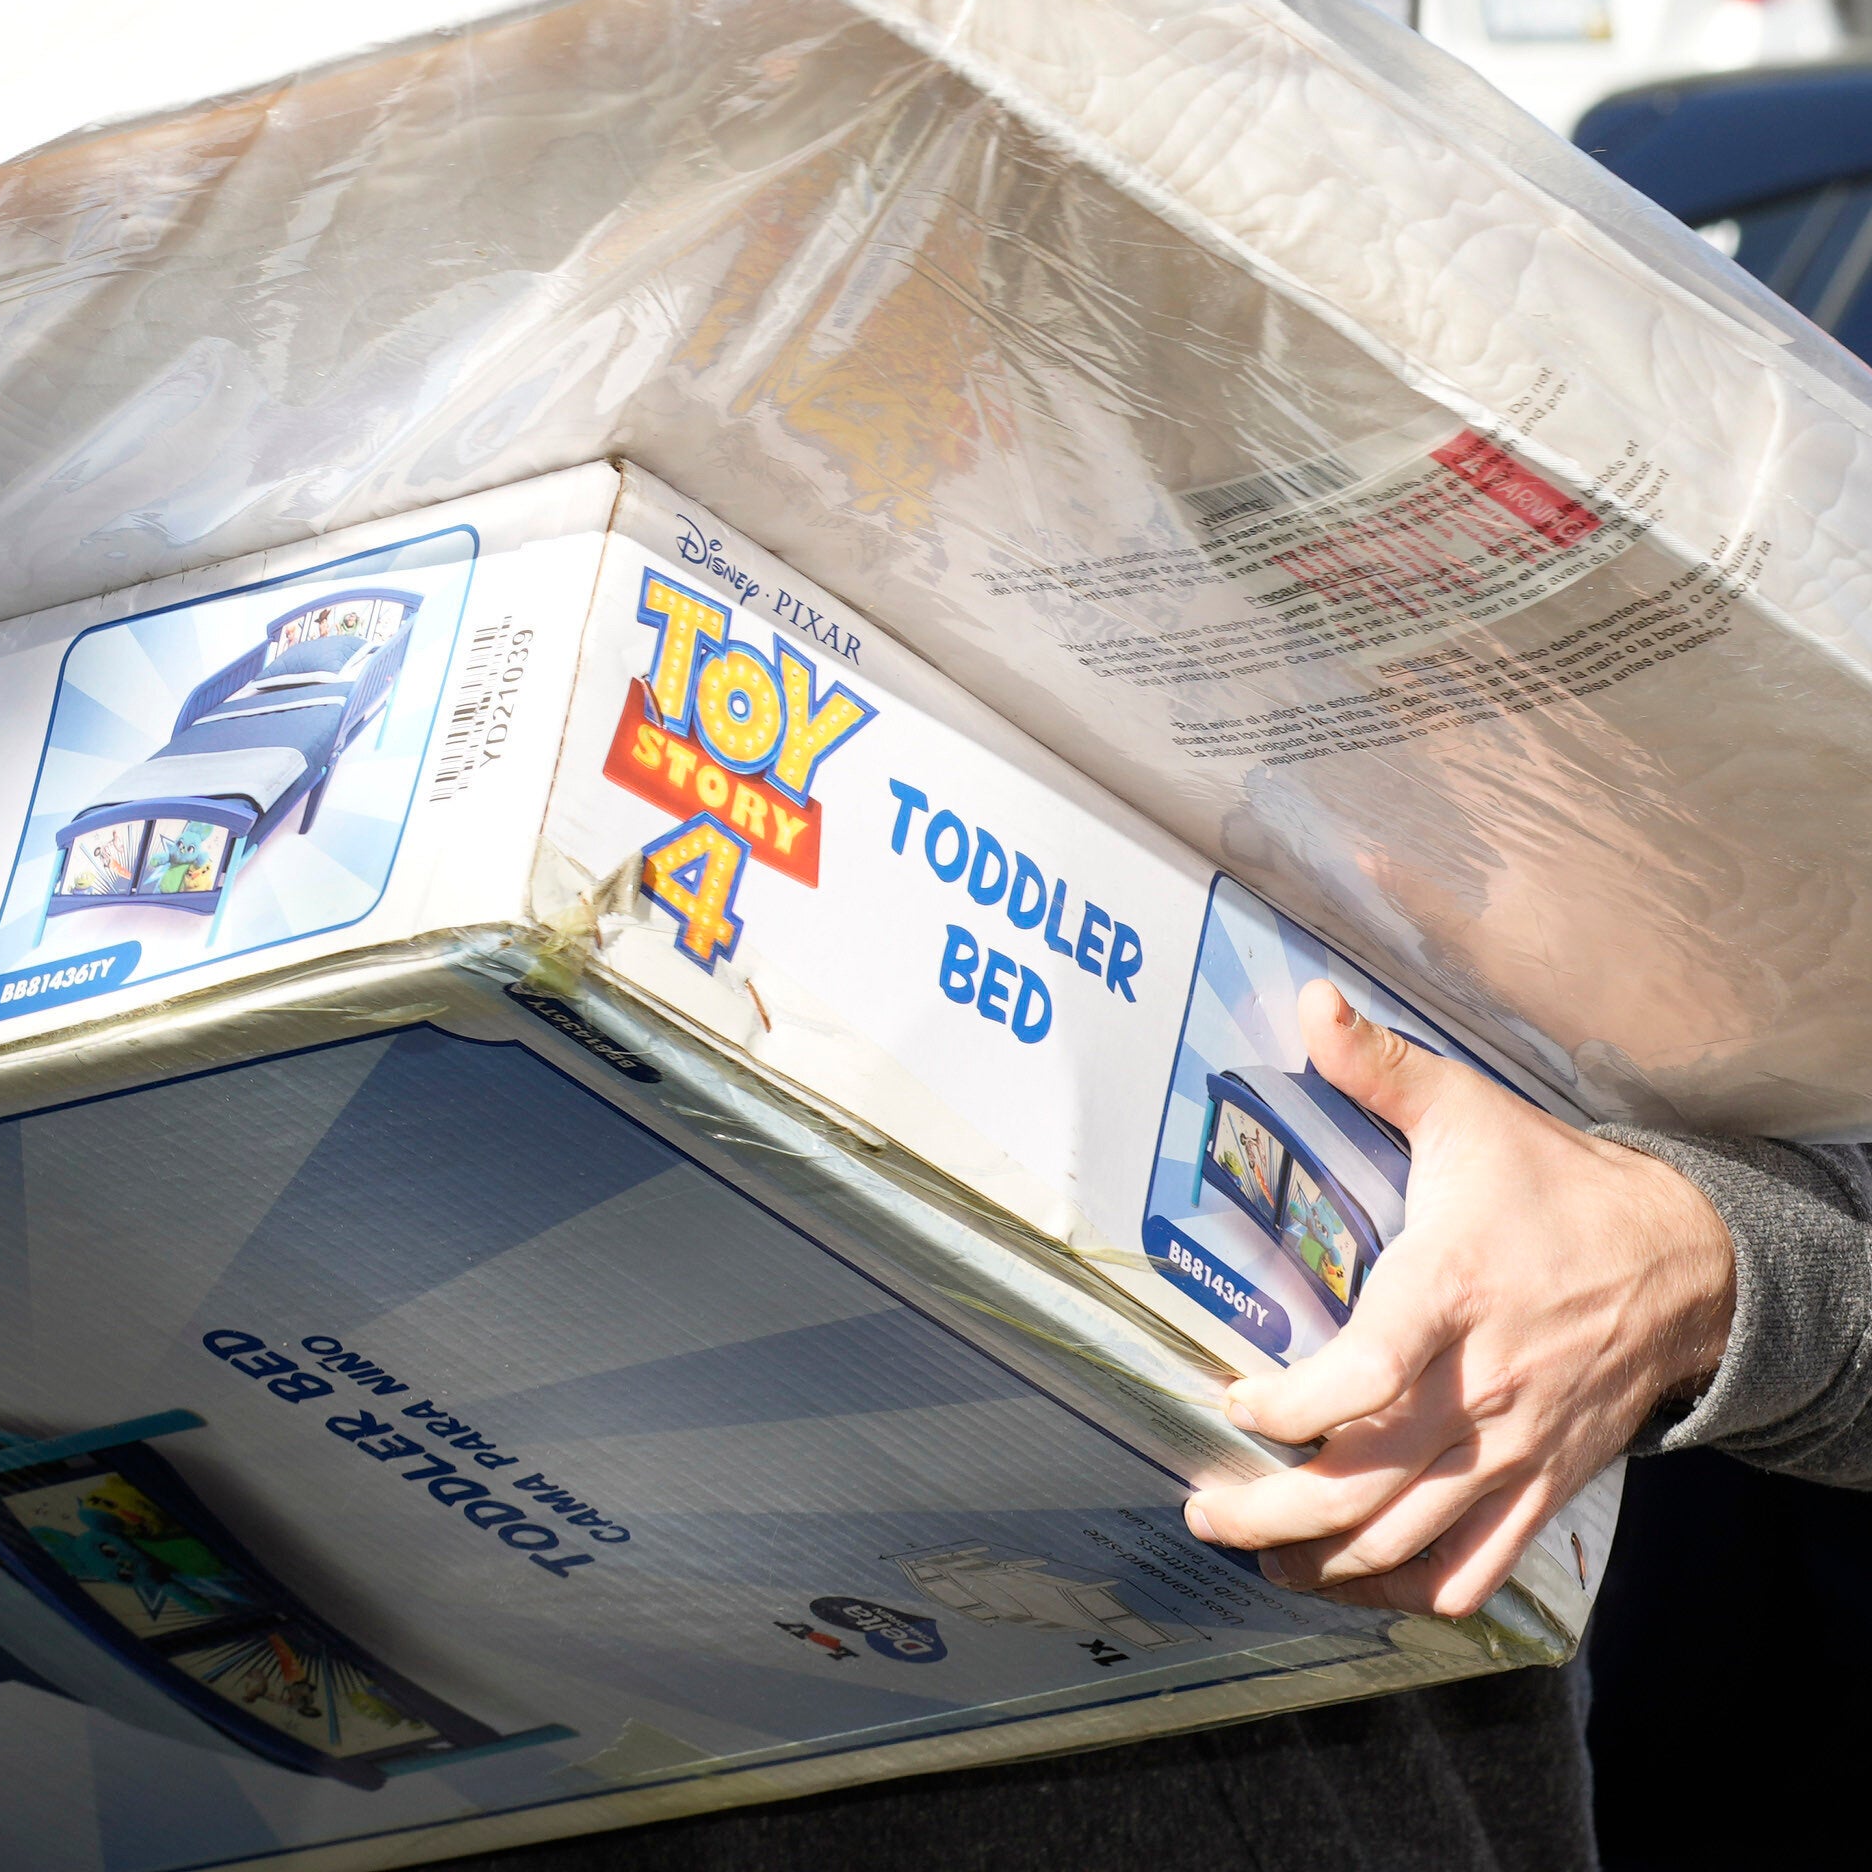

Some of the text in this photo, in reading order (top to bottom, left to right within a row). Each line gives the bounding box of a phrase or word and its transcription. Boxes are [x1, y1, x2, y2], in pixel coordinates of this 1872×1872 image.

[1194, 497, 1266, 530] Warning!
[773, 588, 861, 665] PIXAR
[1378, 646, 1464, 678] Advertencia:
[480, 628, 534, 769] YD21039
[637, 567, 879, 805] TOY
[632, 727, 808, 856] STORY
[640, 811, 752, 973] 4
[890, 779, 1143, 1002] TODDLER
[0, 955, 117, 1005] BB81436TY
[940, 924, 1053, 1044] BED
[528, 1000, 639, 1070] BB81436TY
[1167, 1238, 1270, 1331] BB81436TY
[202, 1328, 595, 1578] TODDLER BED
[300, 1335, 631, 1544] CAMA PARA NIÑO
[1082, 1526, 1245, 1626] Uses standard-size
[1135, 1535, 1252, 1609] crib mattress.
[1206, 1563, 1228, 1576] de
[841, 1604, 934, 1656] Delta
